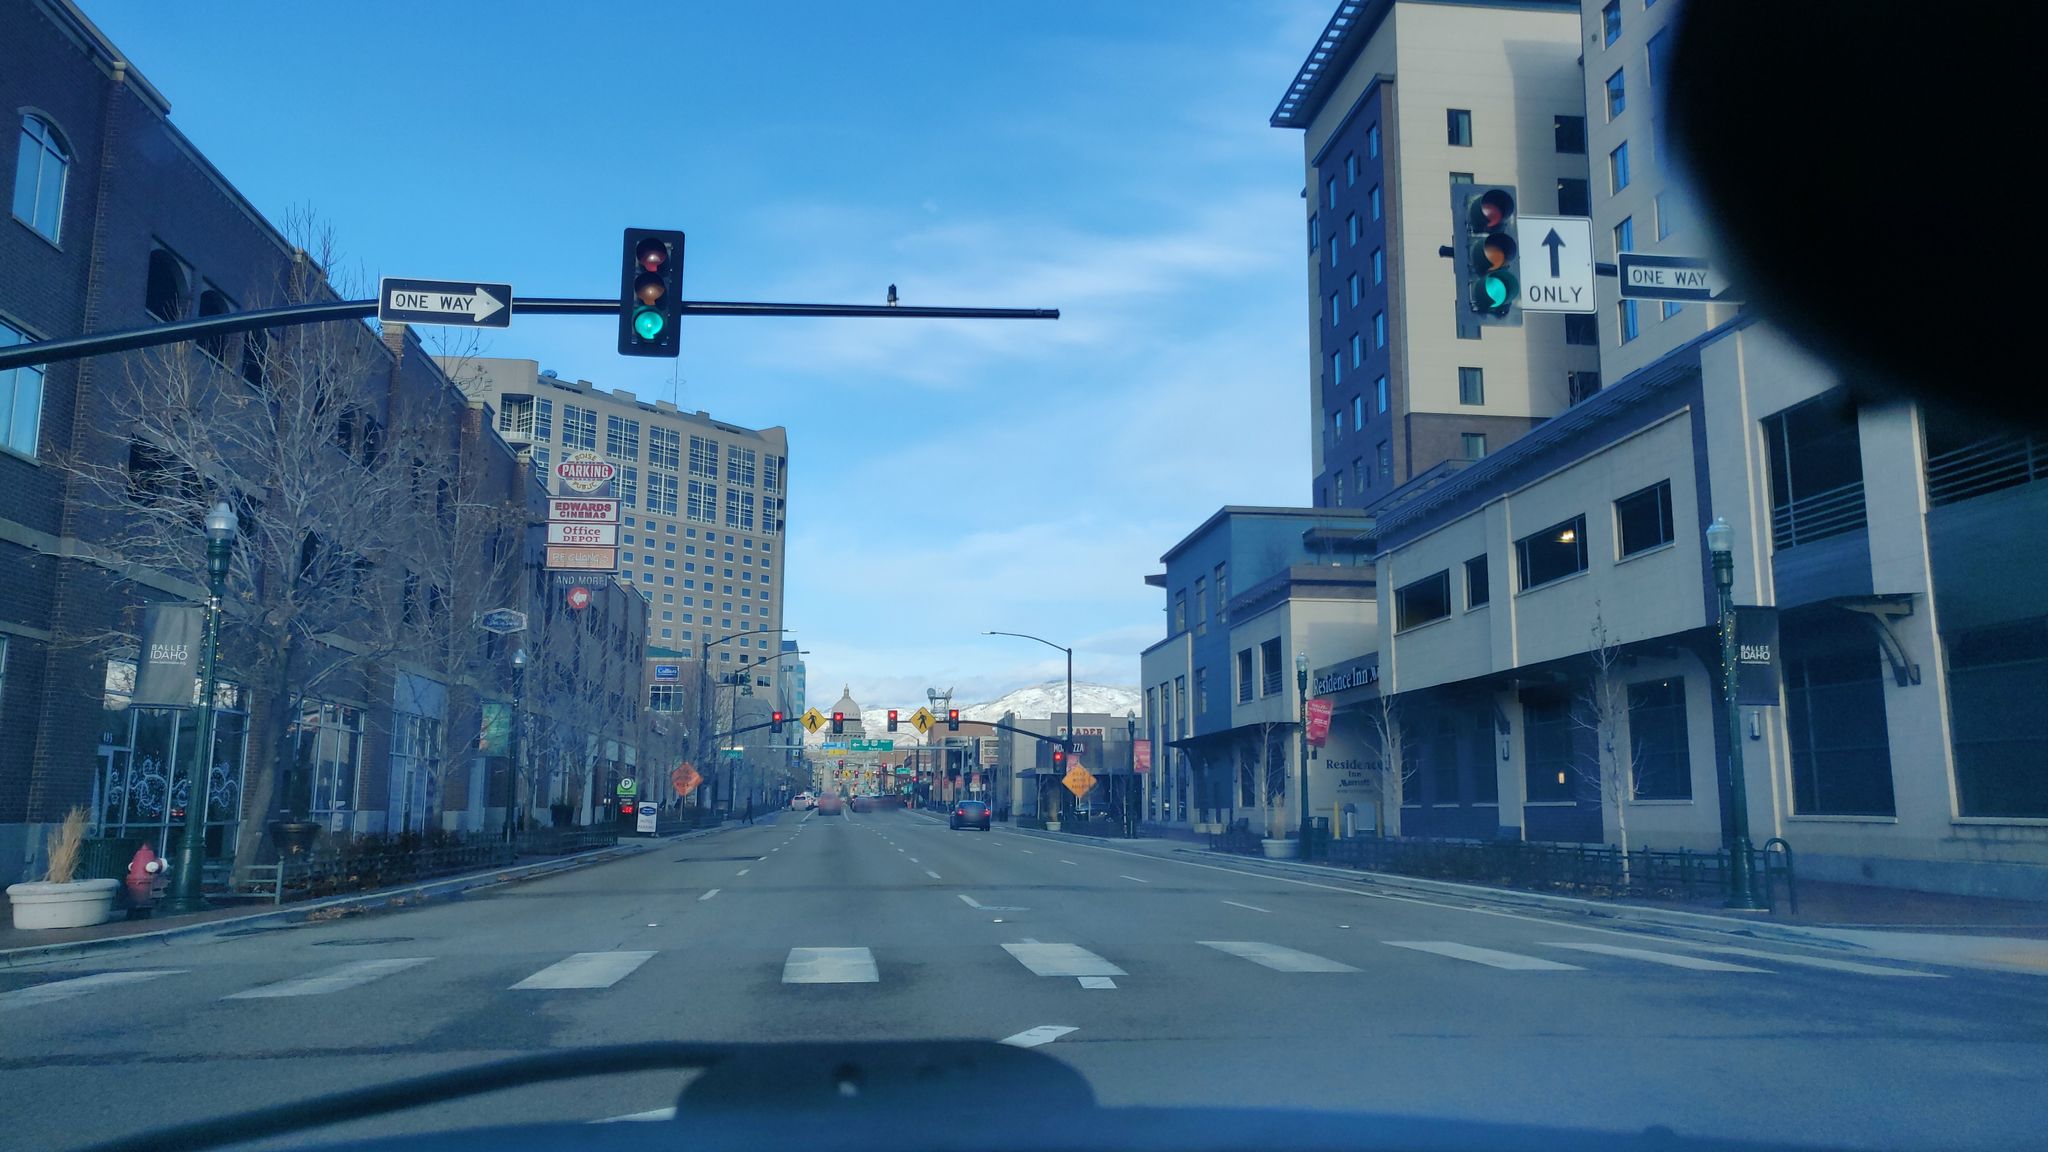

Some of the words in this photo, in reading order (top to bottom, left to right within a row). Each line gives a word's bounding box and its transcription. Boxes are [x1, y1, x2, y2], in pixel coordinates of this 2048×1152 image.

[1632, 269, 1664, 285] ONE
[1674, 271, 1707, 287] WAY
[1529, 286, 1582, 304] ONLY
[395, 293, 429, 309] ONE
[440, 296, 474, 311] WAY
[574, 452, 597, 461] BOISE
[562, 464, 609, 478] PARKING
[572, 480, 598, 490] PUBLIC
[555, 502, 612, 512] EDWARDS
[559, 511, 606, 519] CINEMAS
[563, 526, 601, 536] Office
[563, 535, 600, 543] DEPOT
[556, 576, 575, 585] AND
[150, 650, 188, 660] IDAHO
[1740, 651, 1770, 660] IDAHO
[1313, 673, 1352, 696] Residence
[1352, 667, 1369, 687] Inn
[1060, 728, 1103, 736] TADER
[1326, 759, 1384, 770] Residence
